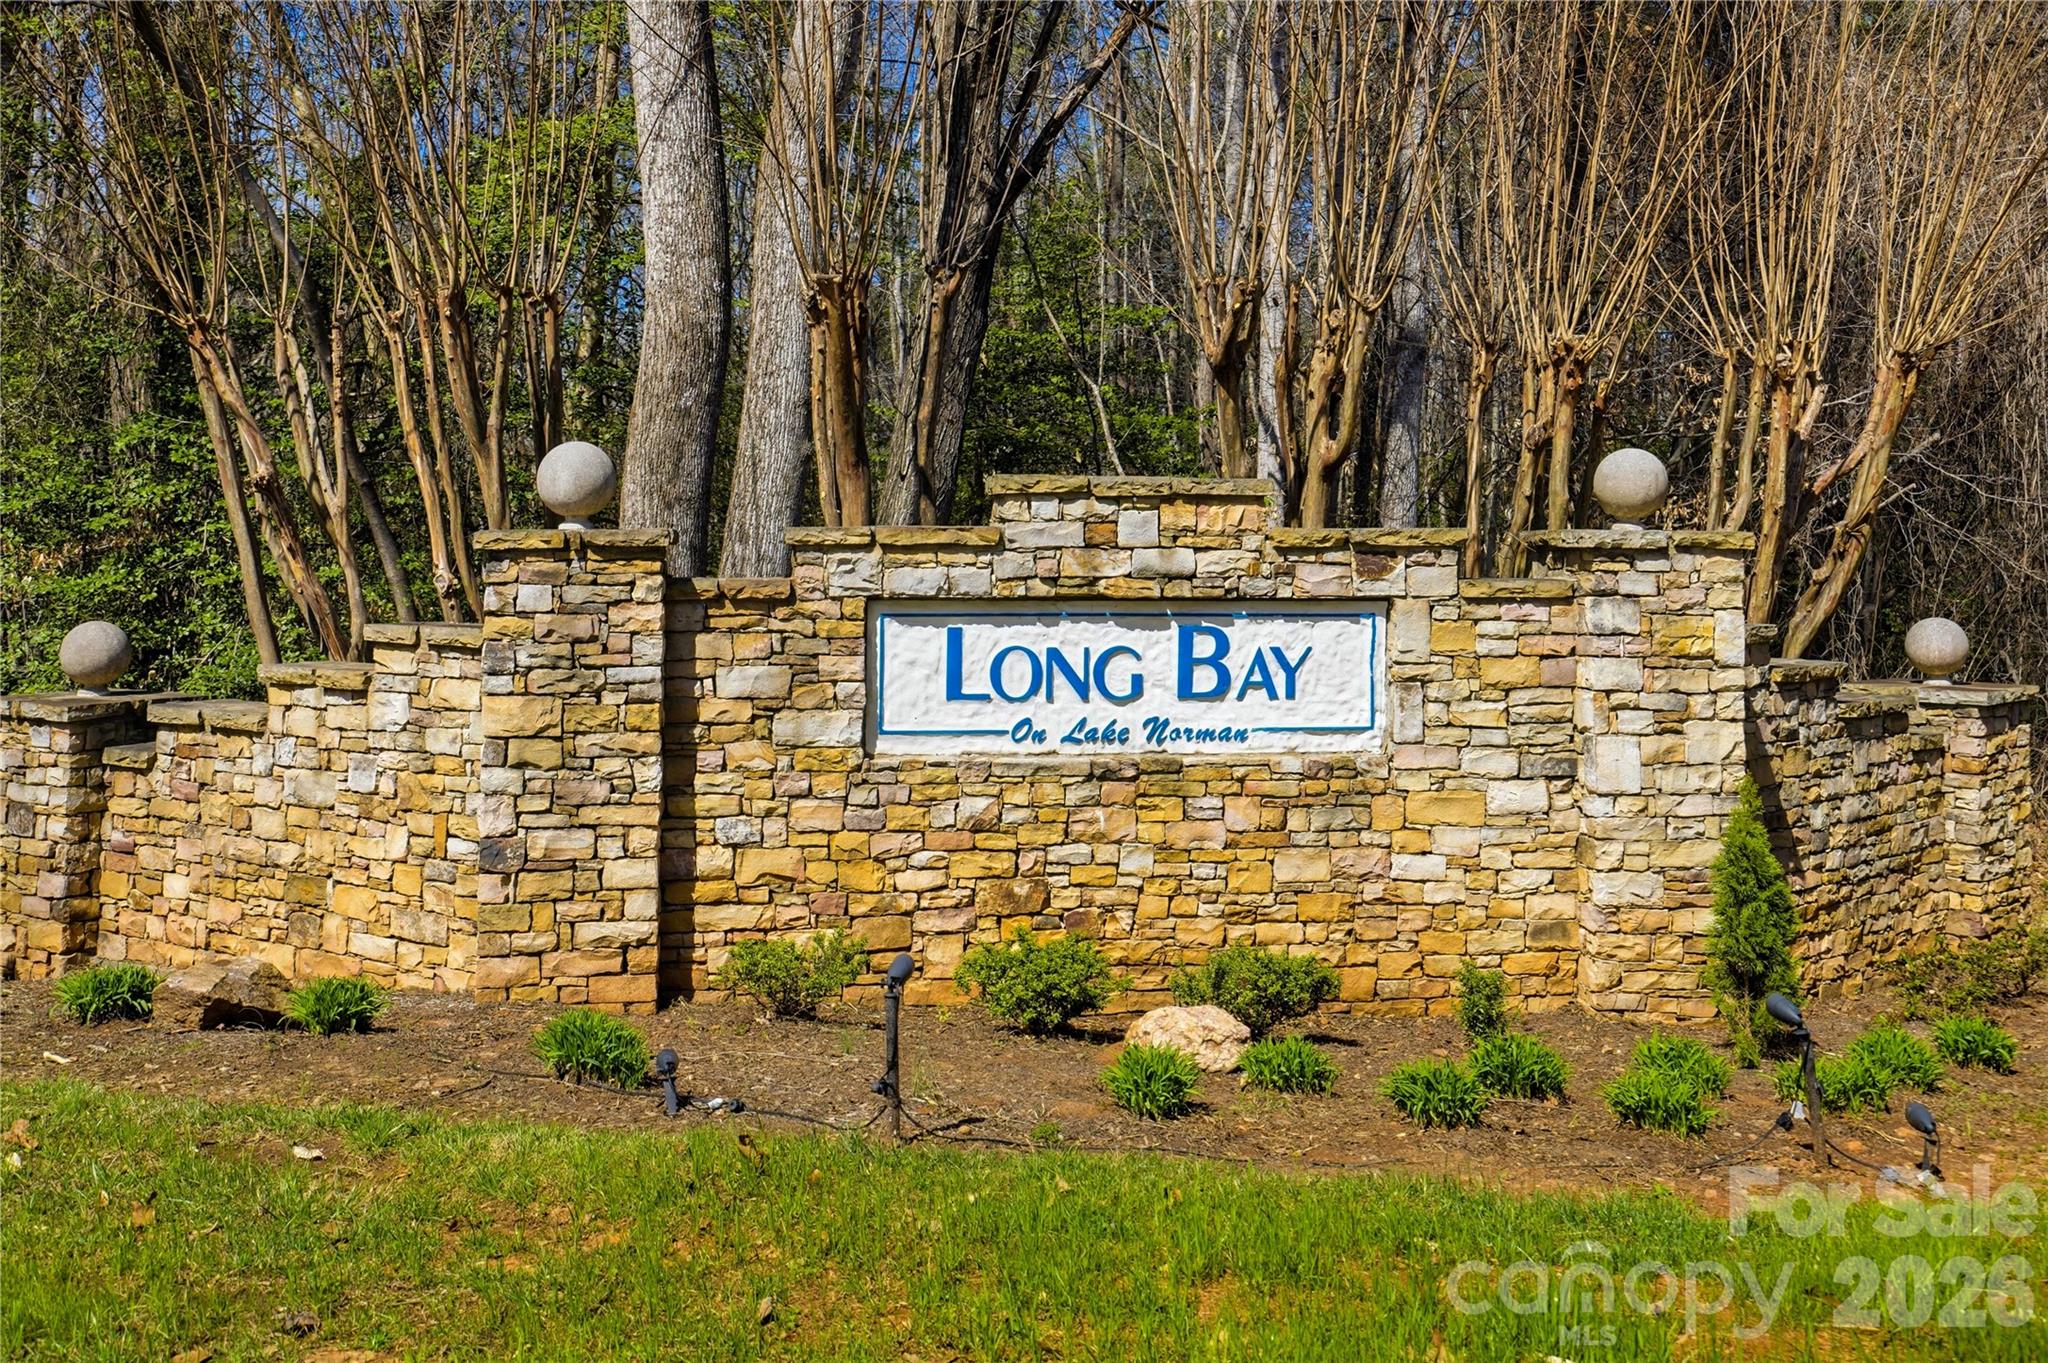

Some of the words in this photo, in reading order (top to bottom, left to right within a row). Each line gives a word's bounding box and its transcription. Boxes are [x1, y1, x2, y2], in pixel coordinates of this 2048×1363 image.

[945, 626, 1144, 702] LONG
[1177, 624, 1312, 701] BAY
[1010, 716, 1047, 745] On
[1060, 716, 1130, 746] Lake
[1142, 716, 1250, 745] Norman
